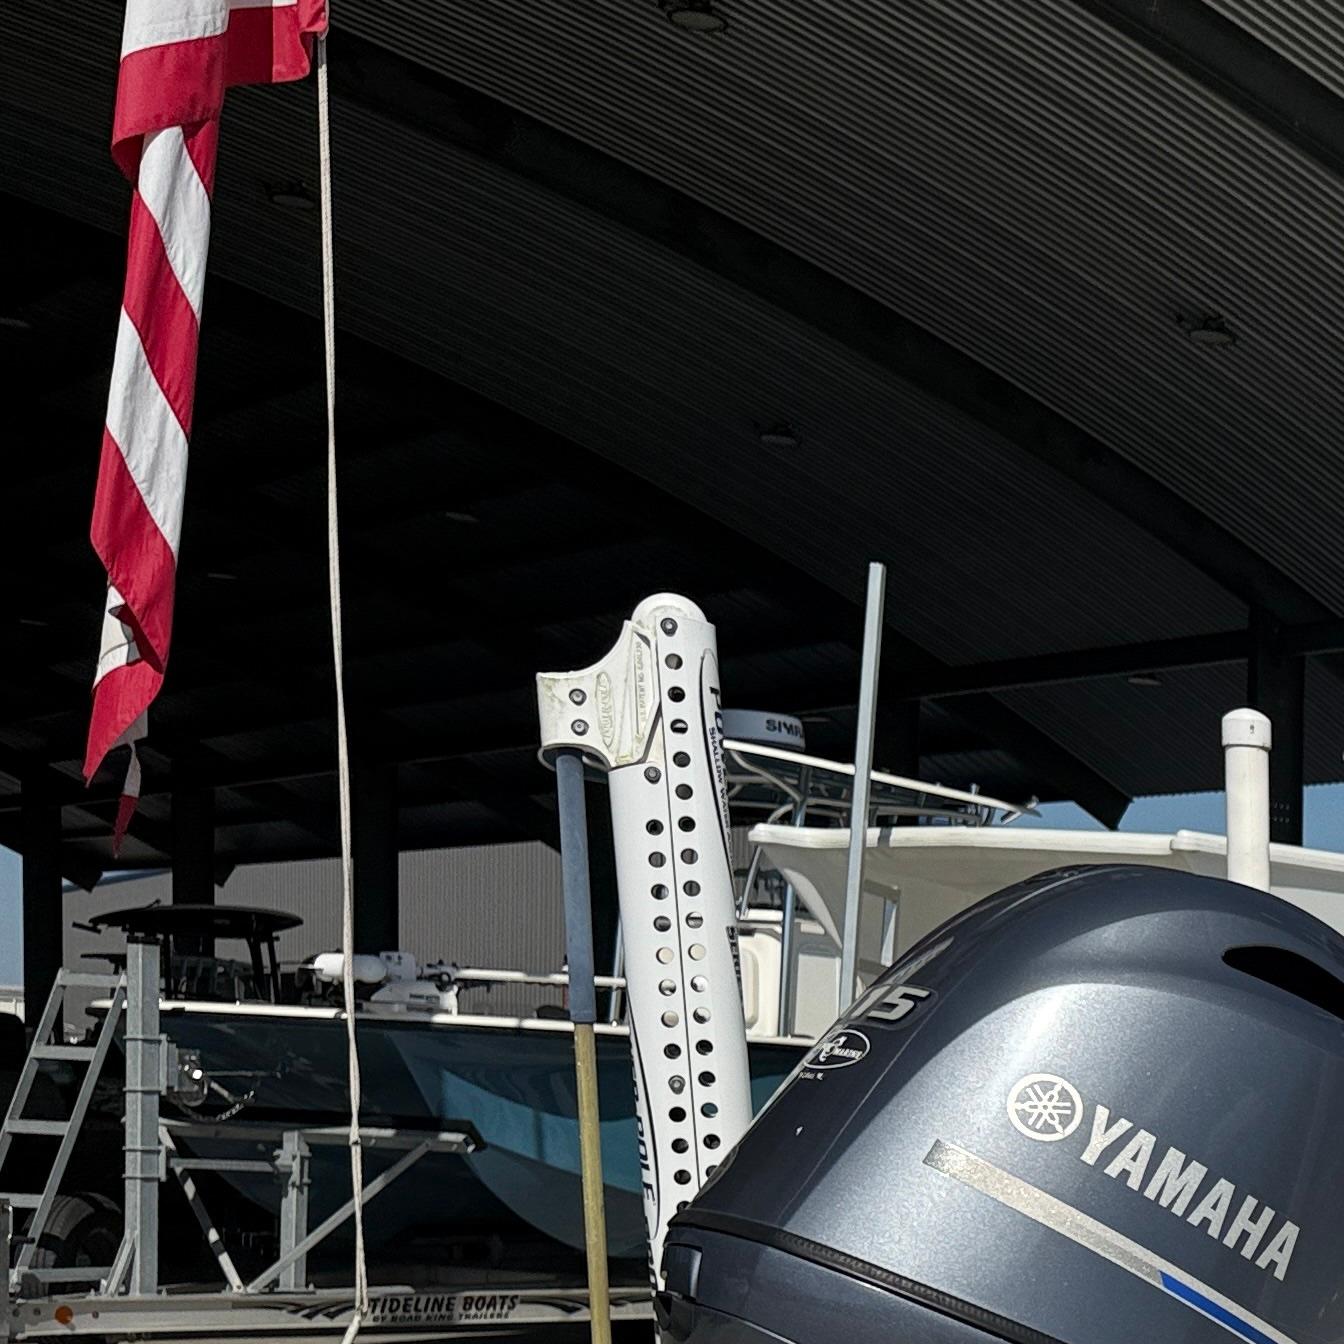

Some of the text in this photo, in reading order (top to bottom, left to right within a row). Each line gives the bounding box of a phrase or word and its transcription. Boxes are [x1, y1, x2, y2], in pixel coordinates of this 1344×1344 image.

[1080, 1104, 1301, 1281] YAMAHA
[369, 1294, 520, 1314] TIDELINE BOATS
